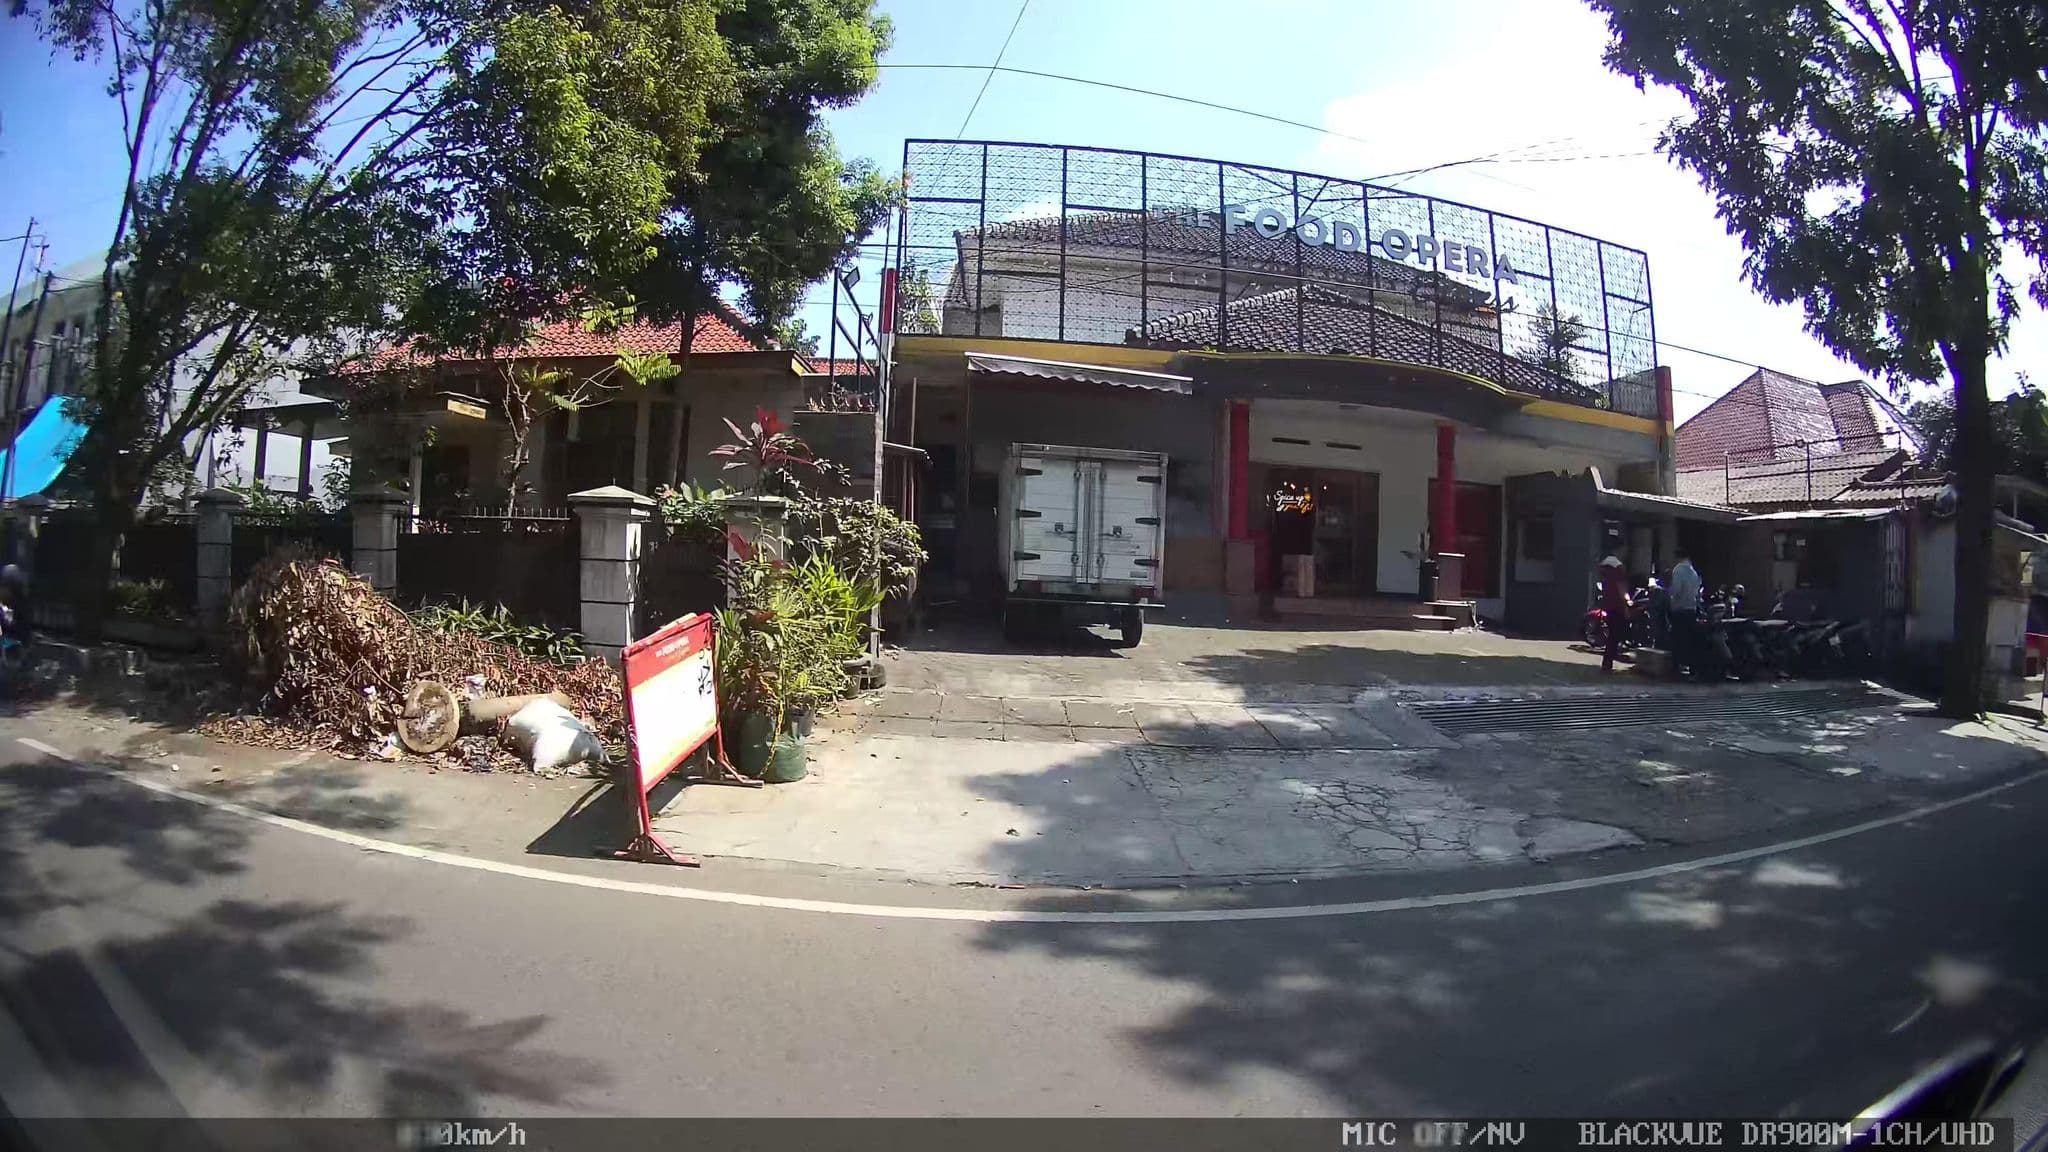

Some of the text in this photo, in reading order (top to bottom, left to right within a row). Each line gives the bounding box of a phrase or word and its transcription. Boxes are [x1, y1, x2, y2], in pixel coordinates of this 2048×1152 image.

[1152, 204, 1519, 286] THE FOOD OPERA
